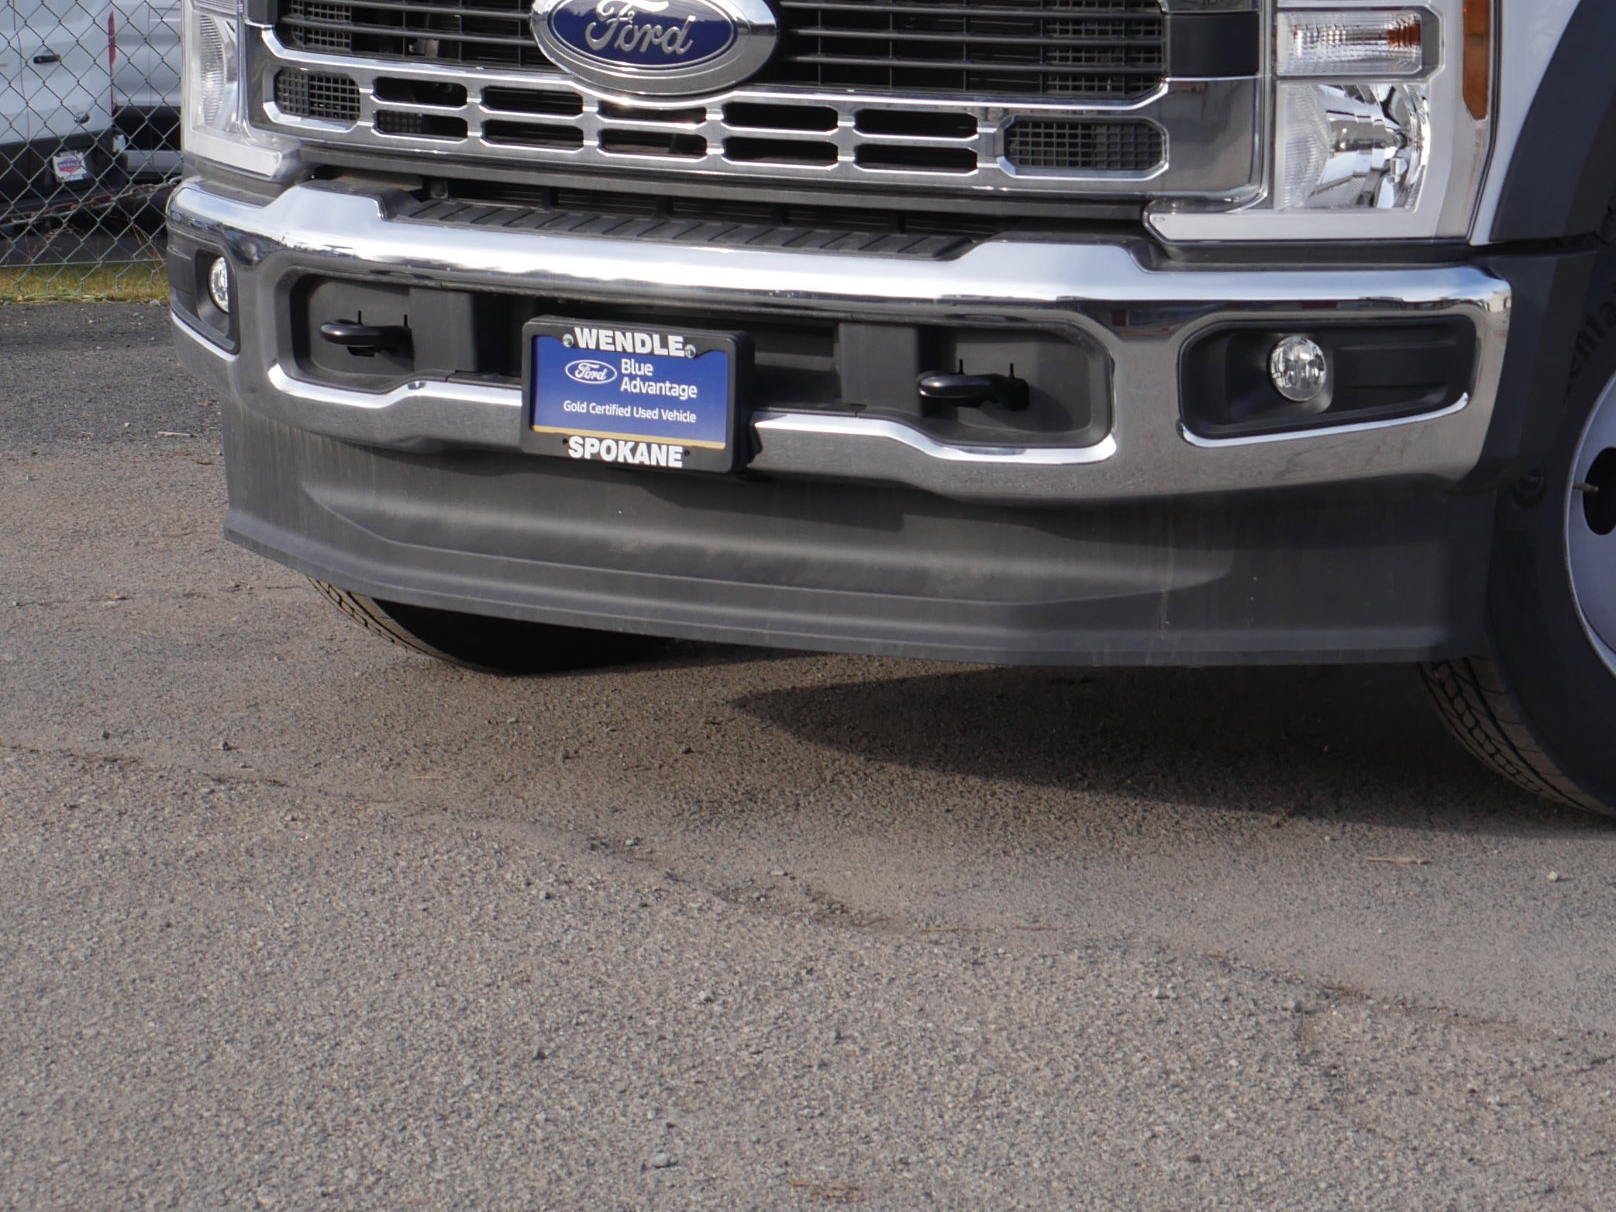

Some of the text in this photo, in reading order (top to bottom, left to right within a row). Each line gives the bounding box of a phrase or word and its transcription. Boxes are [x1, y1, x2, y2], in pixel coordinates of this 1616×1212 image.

[574, 327, 686, 358] WENDLE
[575, 361, 607, 381] Ford
[621, 358, 653, 376] Blue
[620, 377, 698, 400] Advantage
[563, 400, 696, 423] Gold Certified Used Vehicle
[568, 436, 684, 468] SPOKANE
